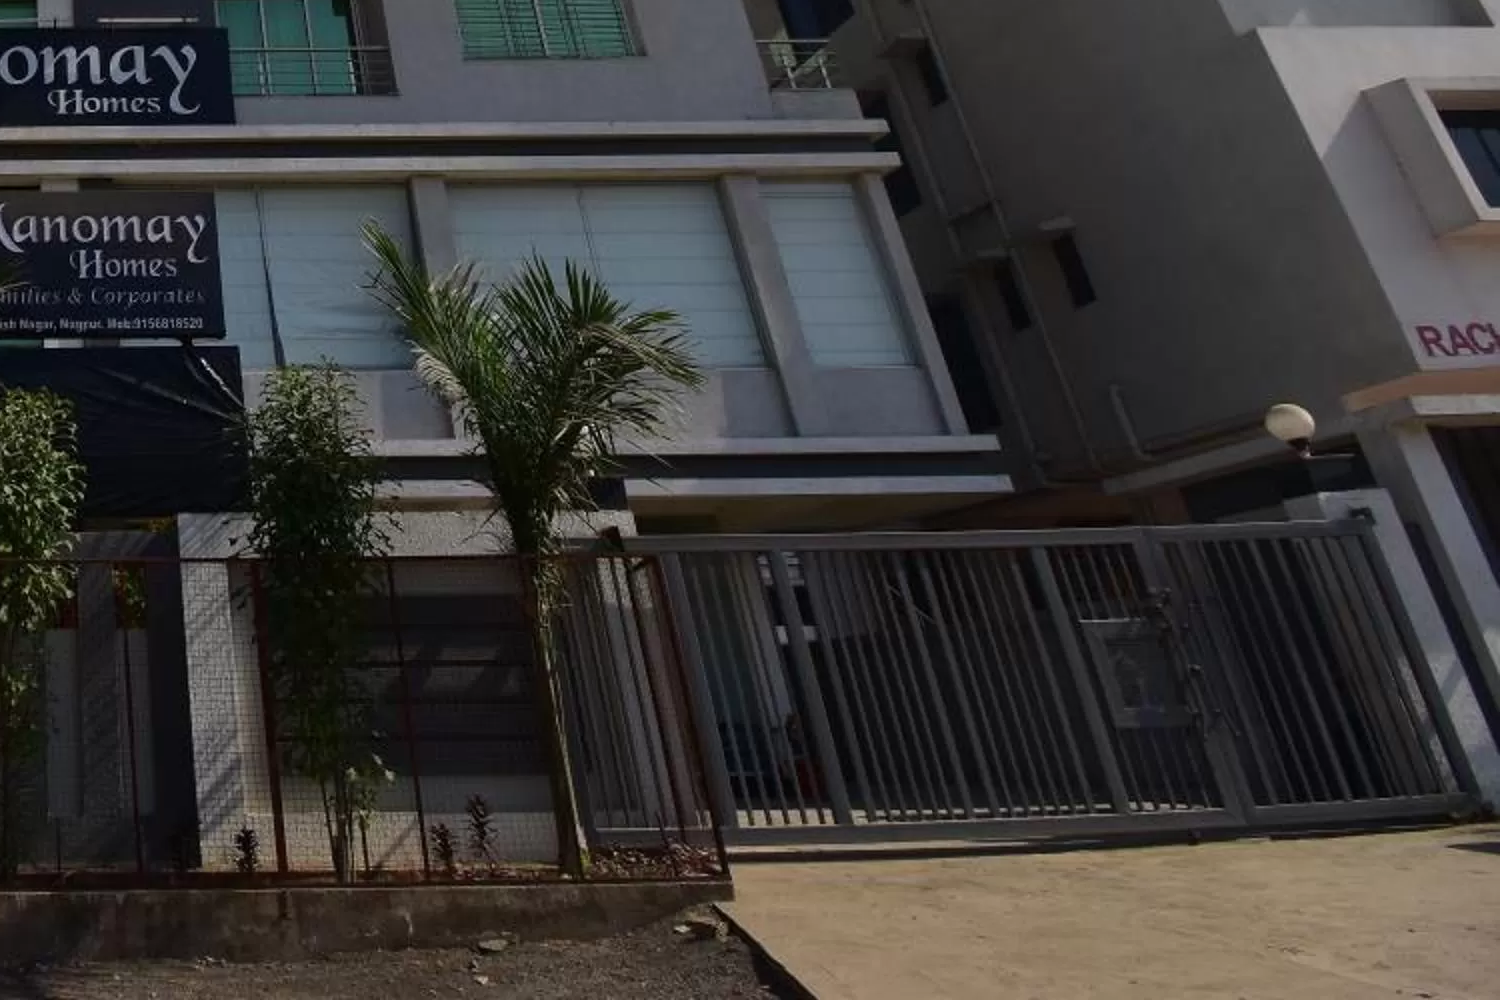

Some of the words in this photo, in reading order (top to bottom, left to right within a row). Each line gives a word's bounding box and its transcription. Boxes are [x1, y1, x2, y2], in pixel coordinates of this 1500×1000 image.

[47, 89, 162, 115] Homes
[69, 249, 178, 280] Homes
[67, 286, 83, 305] &
[91, 286, 207, 309] Corporates
